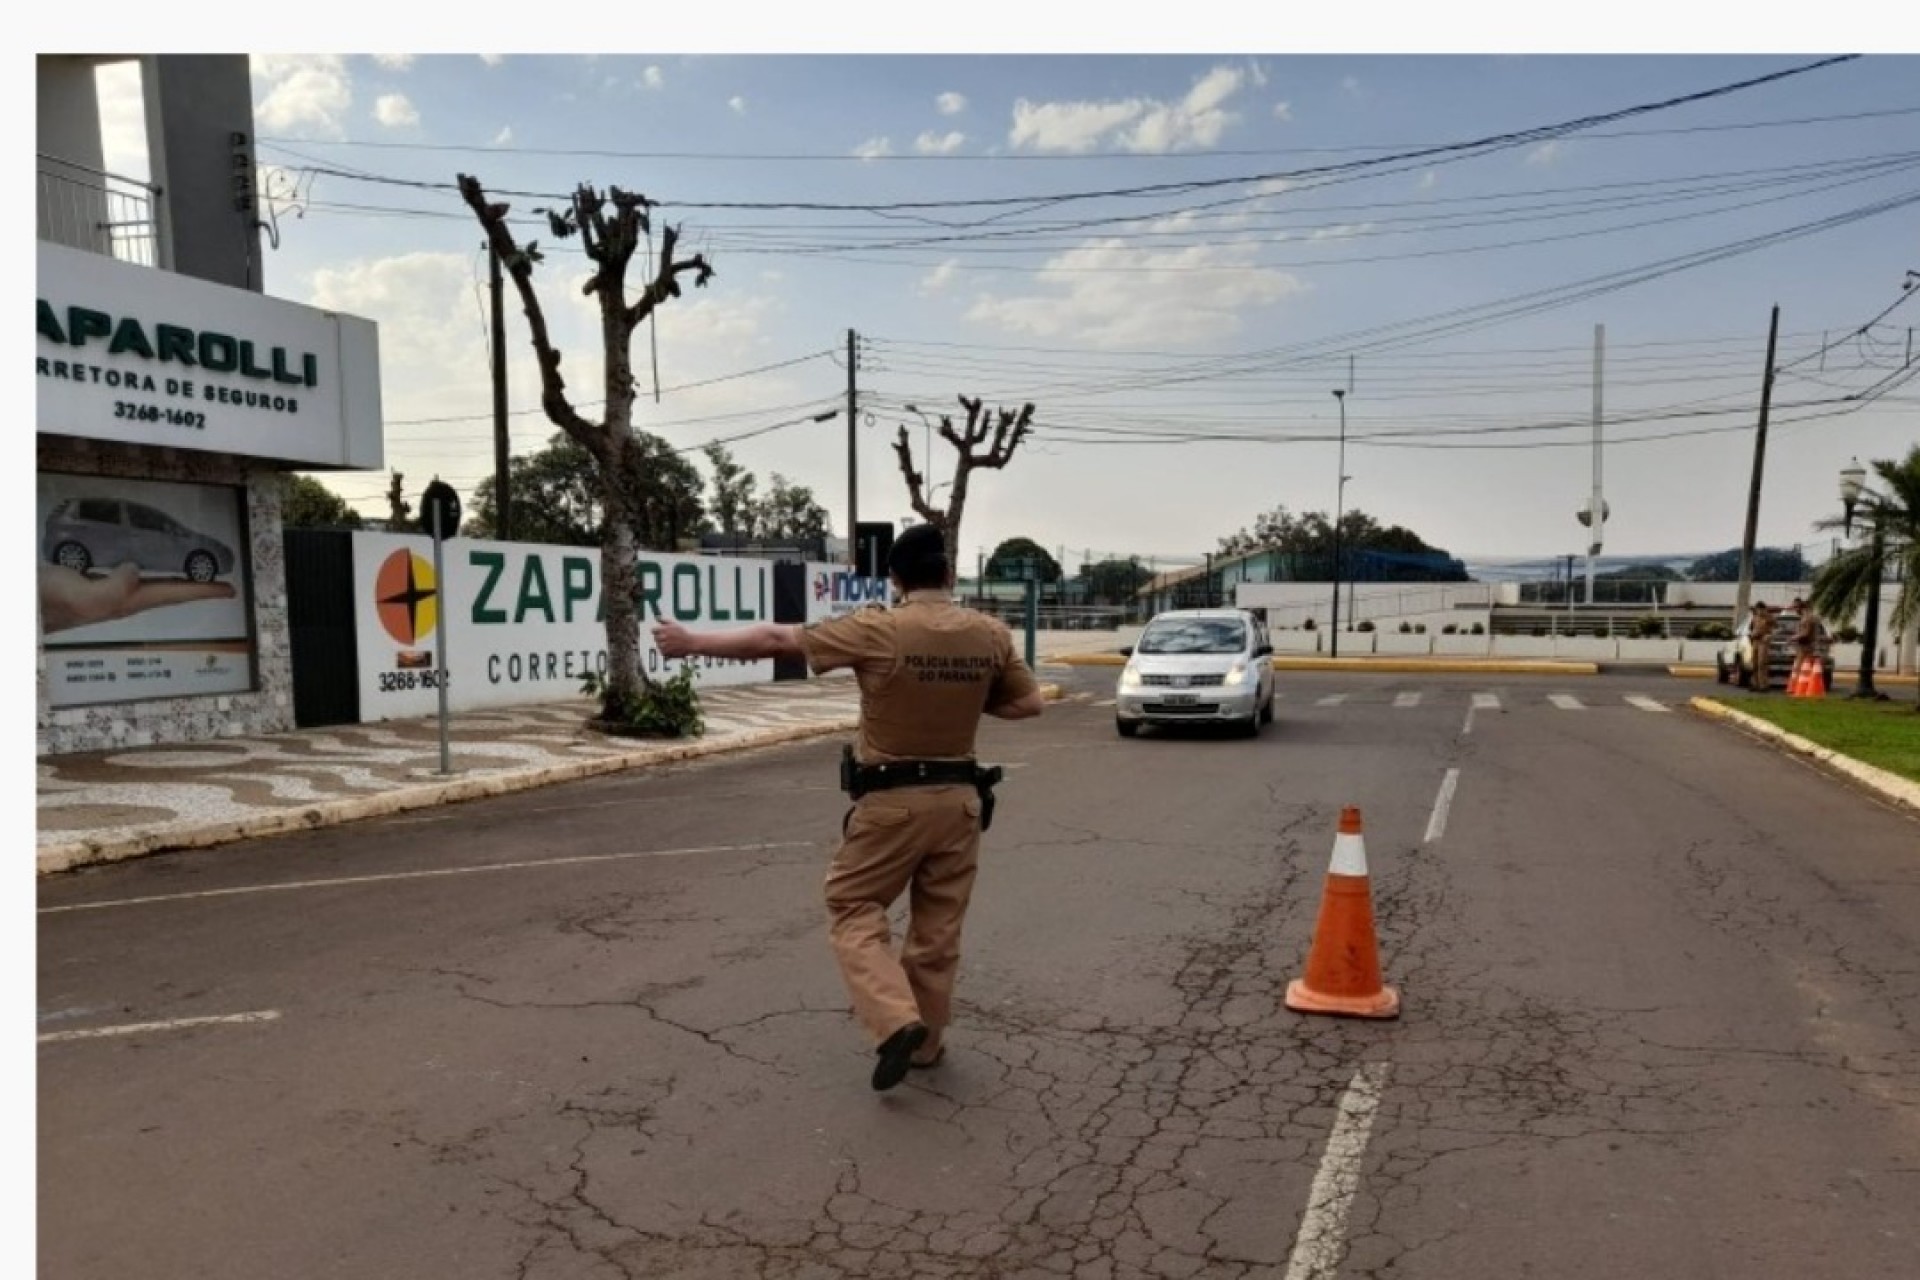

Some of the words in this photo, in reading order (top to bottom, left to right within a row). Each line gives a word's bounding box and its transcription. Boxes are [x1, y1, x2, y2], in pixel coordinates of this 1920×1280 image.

[166, 378, 194, 399] DE
[204, 384, 298, 414] SEGUROS
[114, 400, 206, 430] 3268-1602
[469, 551, 765, 623] ZAPROLLI
